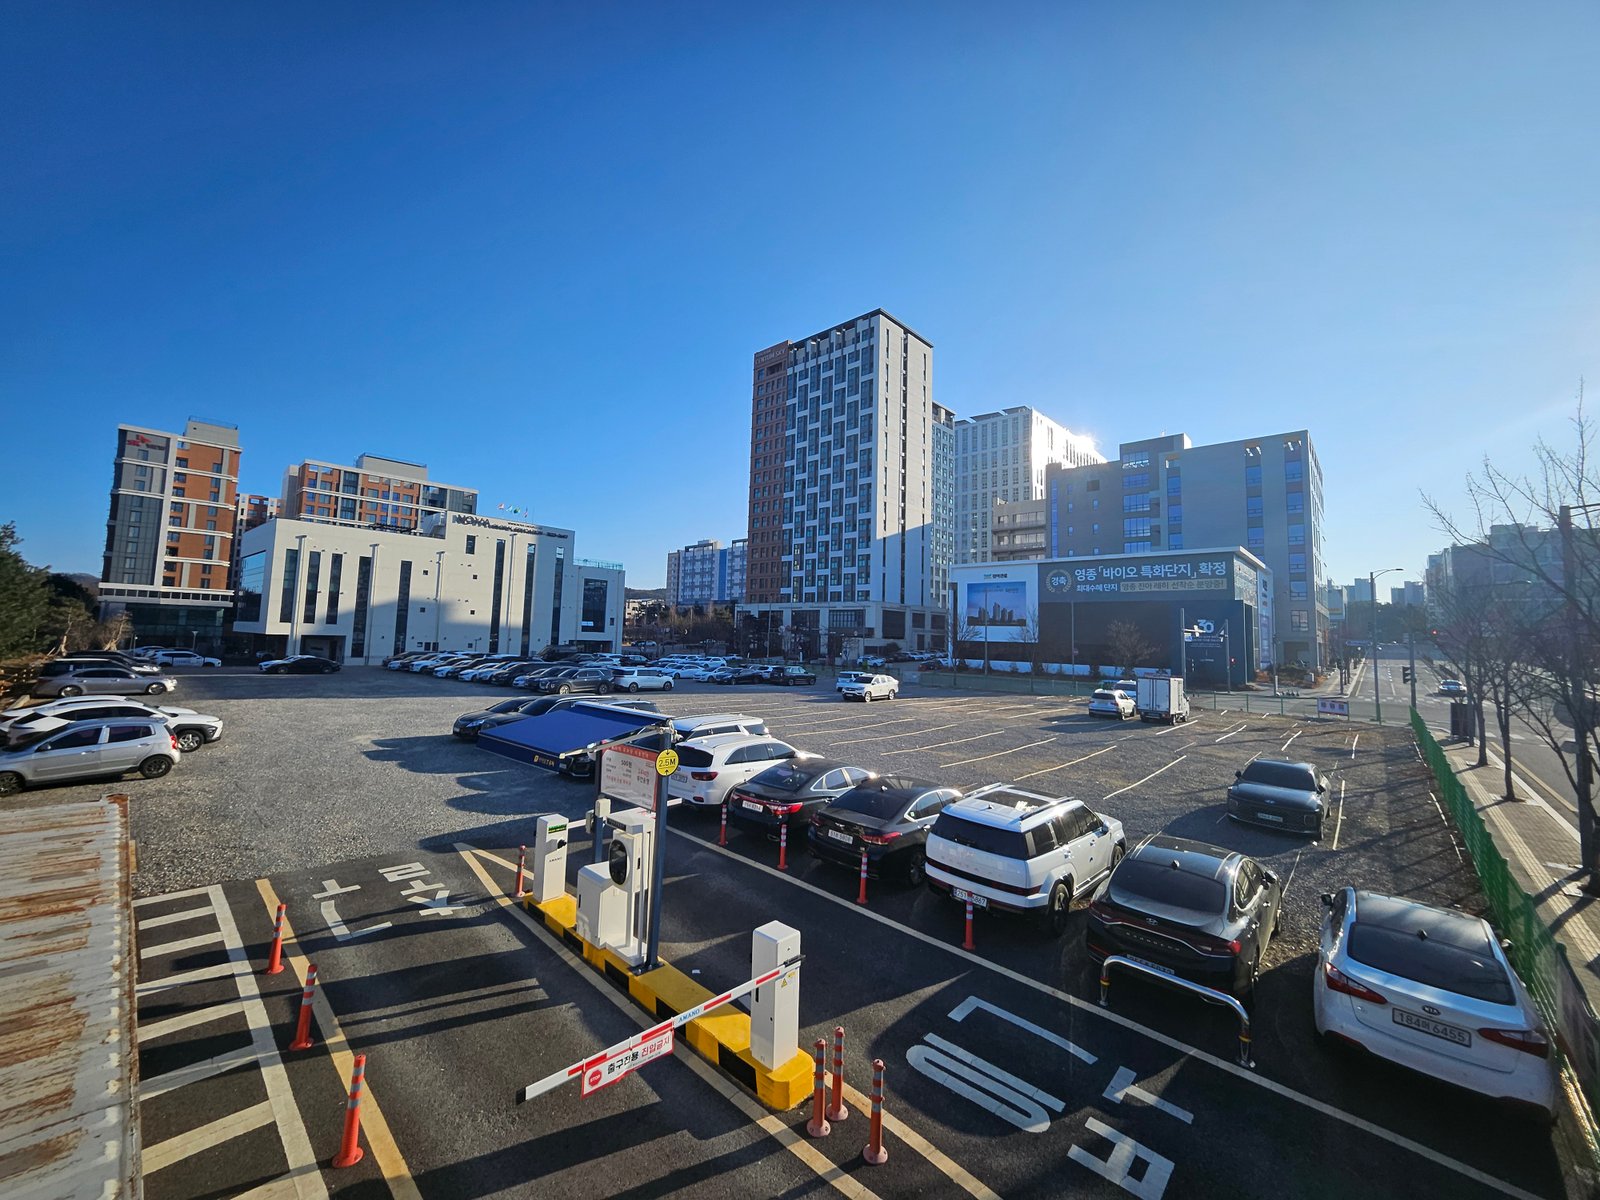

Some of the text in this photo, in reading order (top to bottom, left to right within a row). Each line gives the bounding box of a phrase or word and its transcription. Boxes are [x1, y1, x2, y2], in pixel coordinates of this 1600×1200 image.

[1074, 568, 1097, 582] 영종
[1198, 561, 1226, 577] 확정
[1103, 583, 1118, 592] 단지
[658, 758, 676, 768] 2.5M
[678, 1008, 701, 1023] AMANO
[607, 1051, 639, 1075] 출구전용
[641, 1035, 670, 1057] 진입금지
[590, 1074, 601, 1083] STOP
